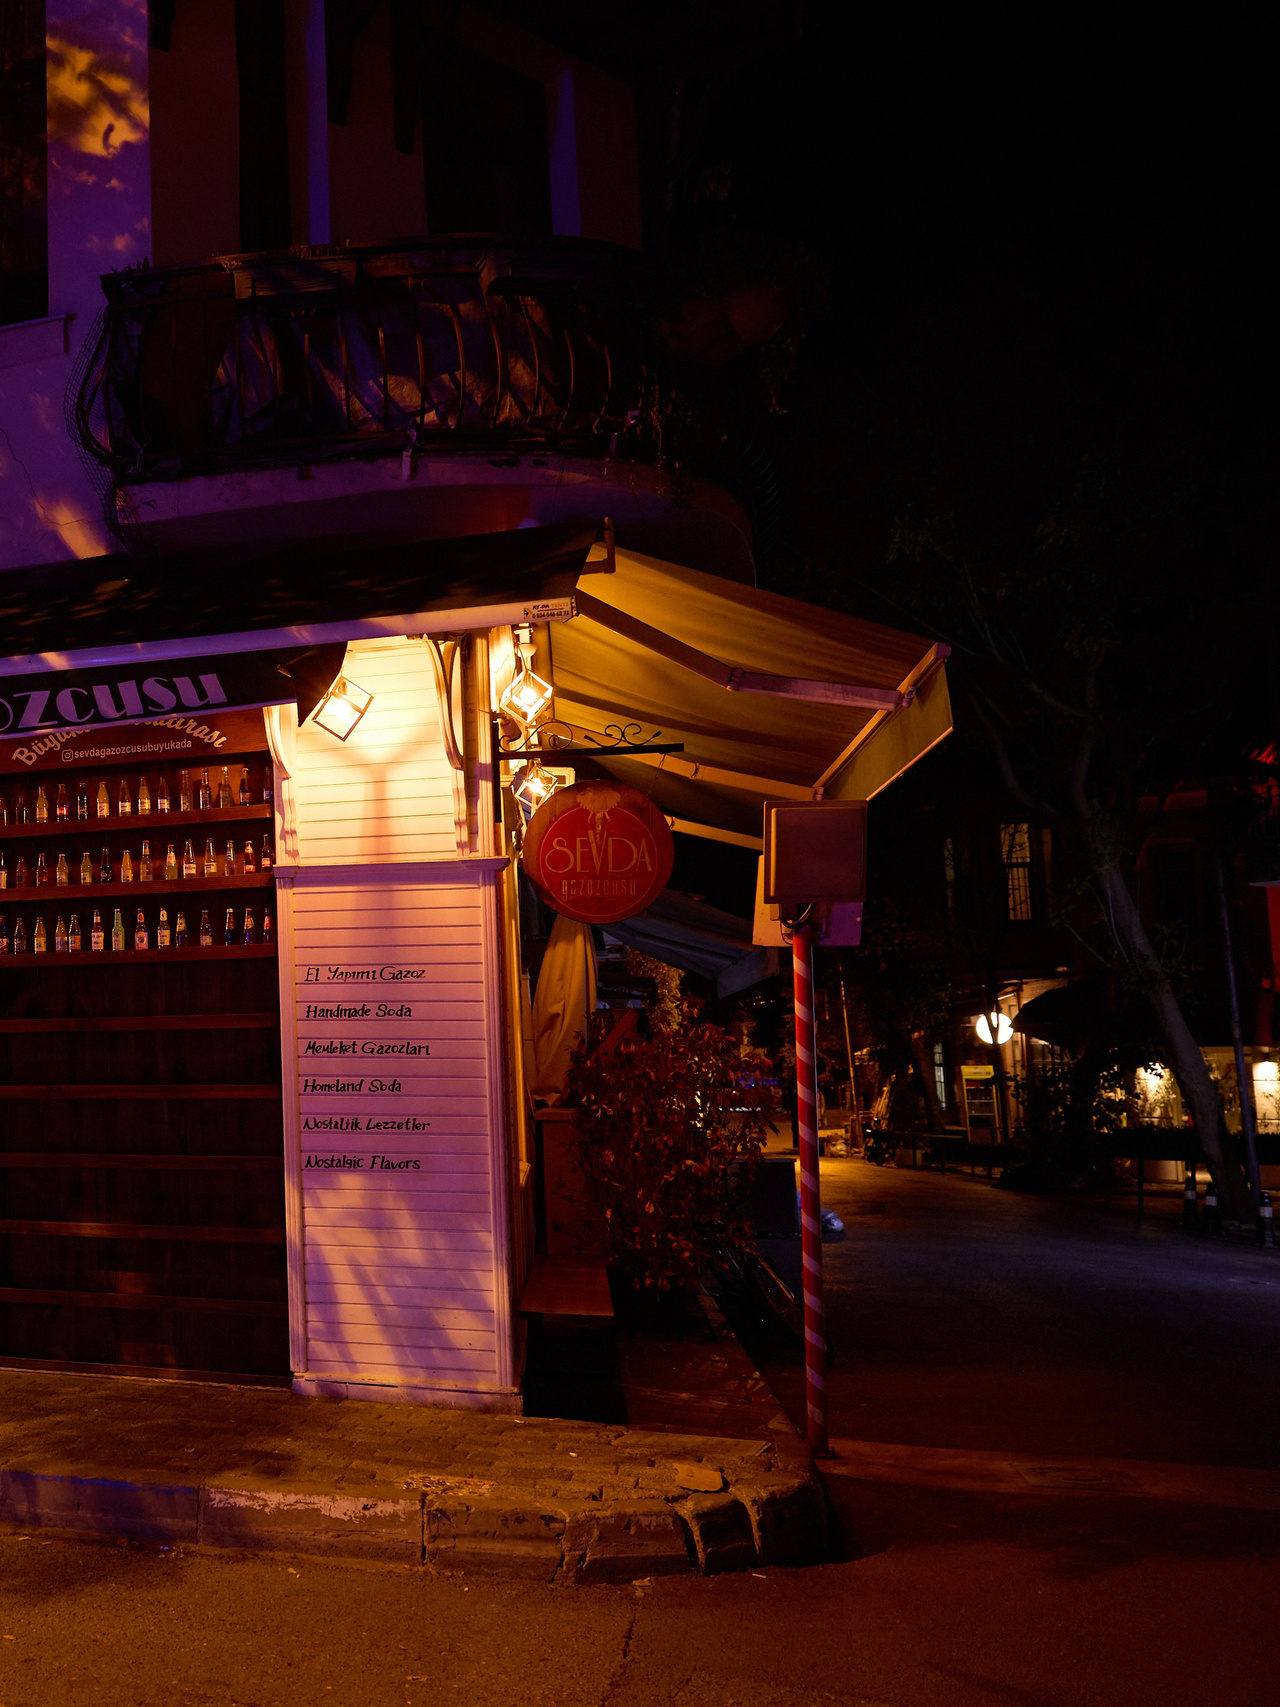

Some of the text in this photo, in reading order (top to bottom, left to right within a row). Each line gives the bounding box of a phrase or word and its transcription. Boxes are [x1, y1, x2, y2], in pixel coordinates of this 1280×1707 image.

[74, 739, 192, 759] sevdagazozcusubuyukada
[544, 829, 653, 876] SEVDA
[561, 879, 637, 901] gazozcusu
[304, 967, 320, 982] El
[379, 965, 427, 981] Gazoz
[305, 1003, 412, 1018] Handmade Soda
[361, 1041, 431, 1056] Gazozları
[302, 1078, 402, 1093] Homeland Soda
[302, 1116, 431, 1132] Nostaljik Lezzetler
[304, 1154, 421, 1170] Nostalgic Flavors
